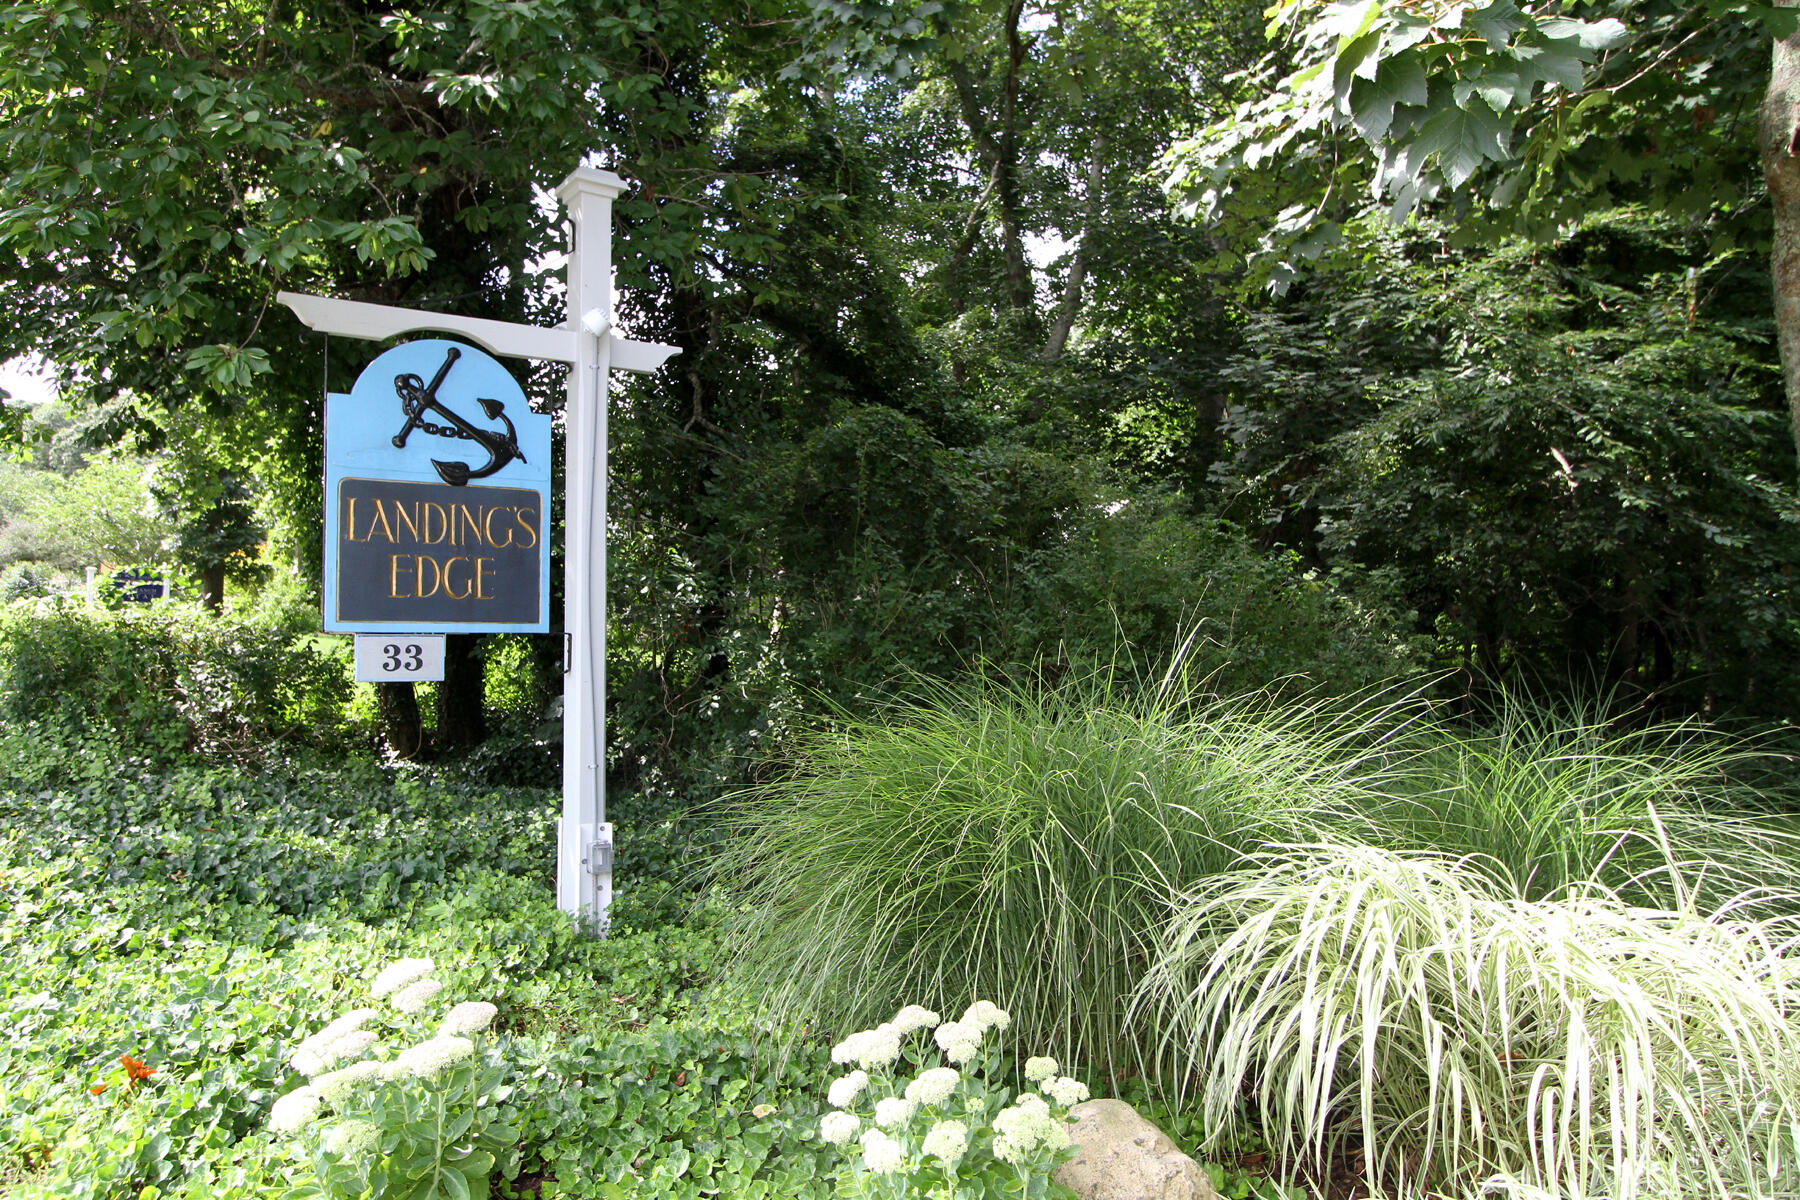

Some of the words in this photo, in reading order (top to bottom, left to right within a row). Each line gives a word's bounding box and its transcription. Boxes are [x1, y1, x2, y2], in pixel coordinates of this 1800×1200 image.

[346, 497, 537, 549] LANDING'S
[388, 554, 496, 600] EDGE
[382, 644, 424, 672] 33
